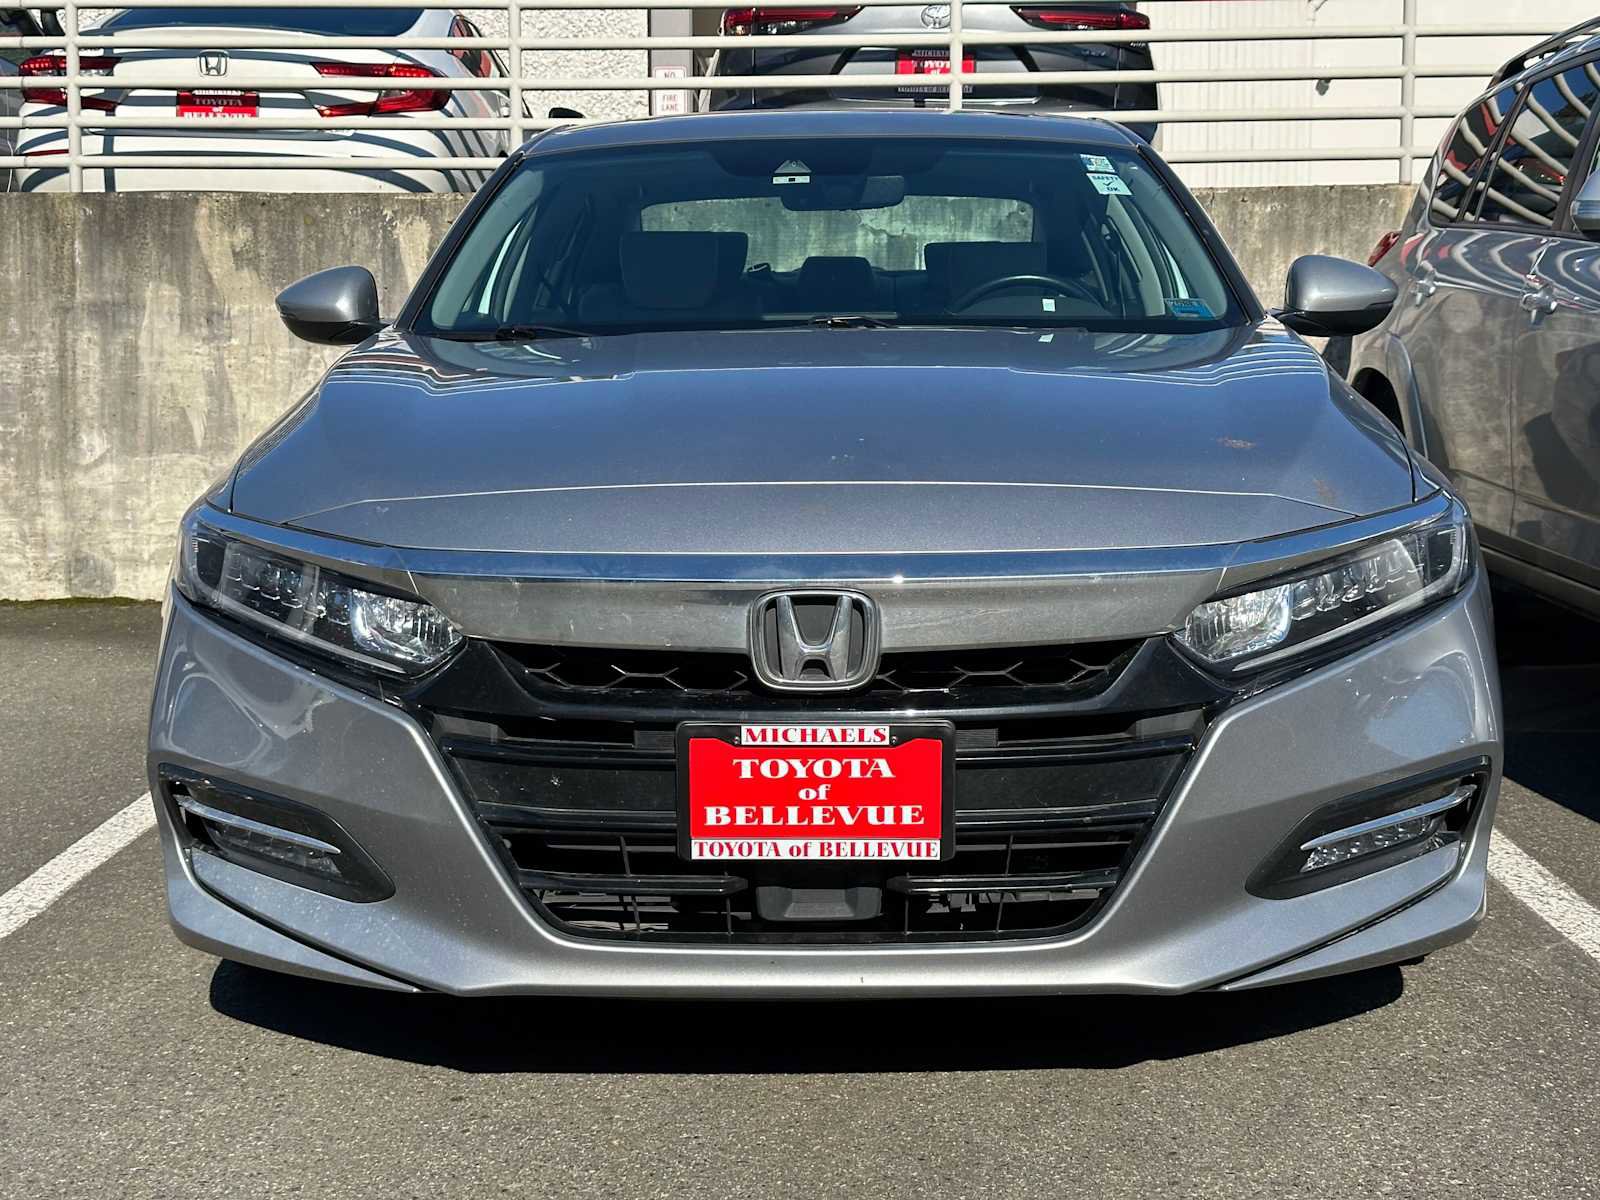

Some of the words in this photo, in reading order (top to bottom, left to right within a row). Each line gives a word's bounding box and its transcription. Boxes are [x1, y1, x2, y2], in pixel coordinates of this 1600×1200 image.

[194, 98, 243, 106] TOYOTA
[662, 94, 678, 102] FIRE
[661, 103, 678, 112] LANE
[744, 727, 887, 744] MICHAELS
[732, 758, 896, 779] TOYOTA
[797, 784, 831, 801] of
[703, 804, 925, 826] BELLEVUE
[693, 841, 782, 858] TOYOTA
[788, 841, 813, 858] of
[819, 841, 938, 858] BELLEVUE
